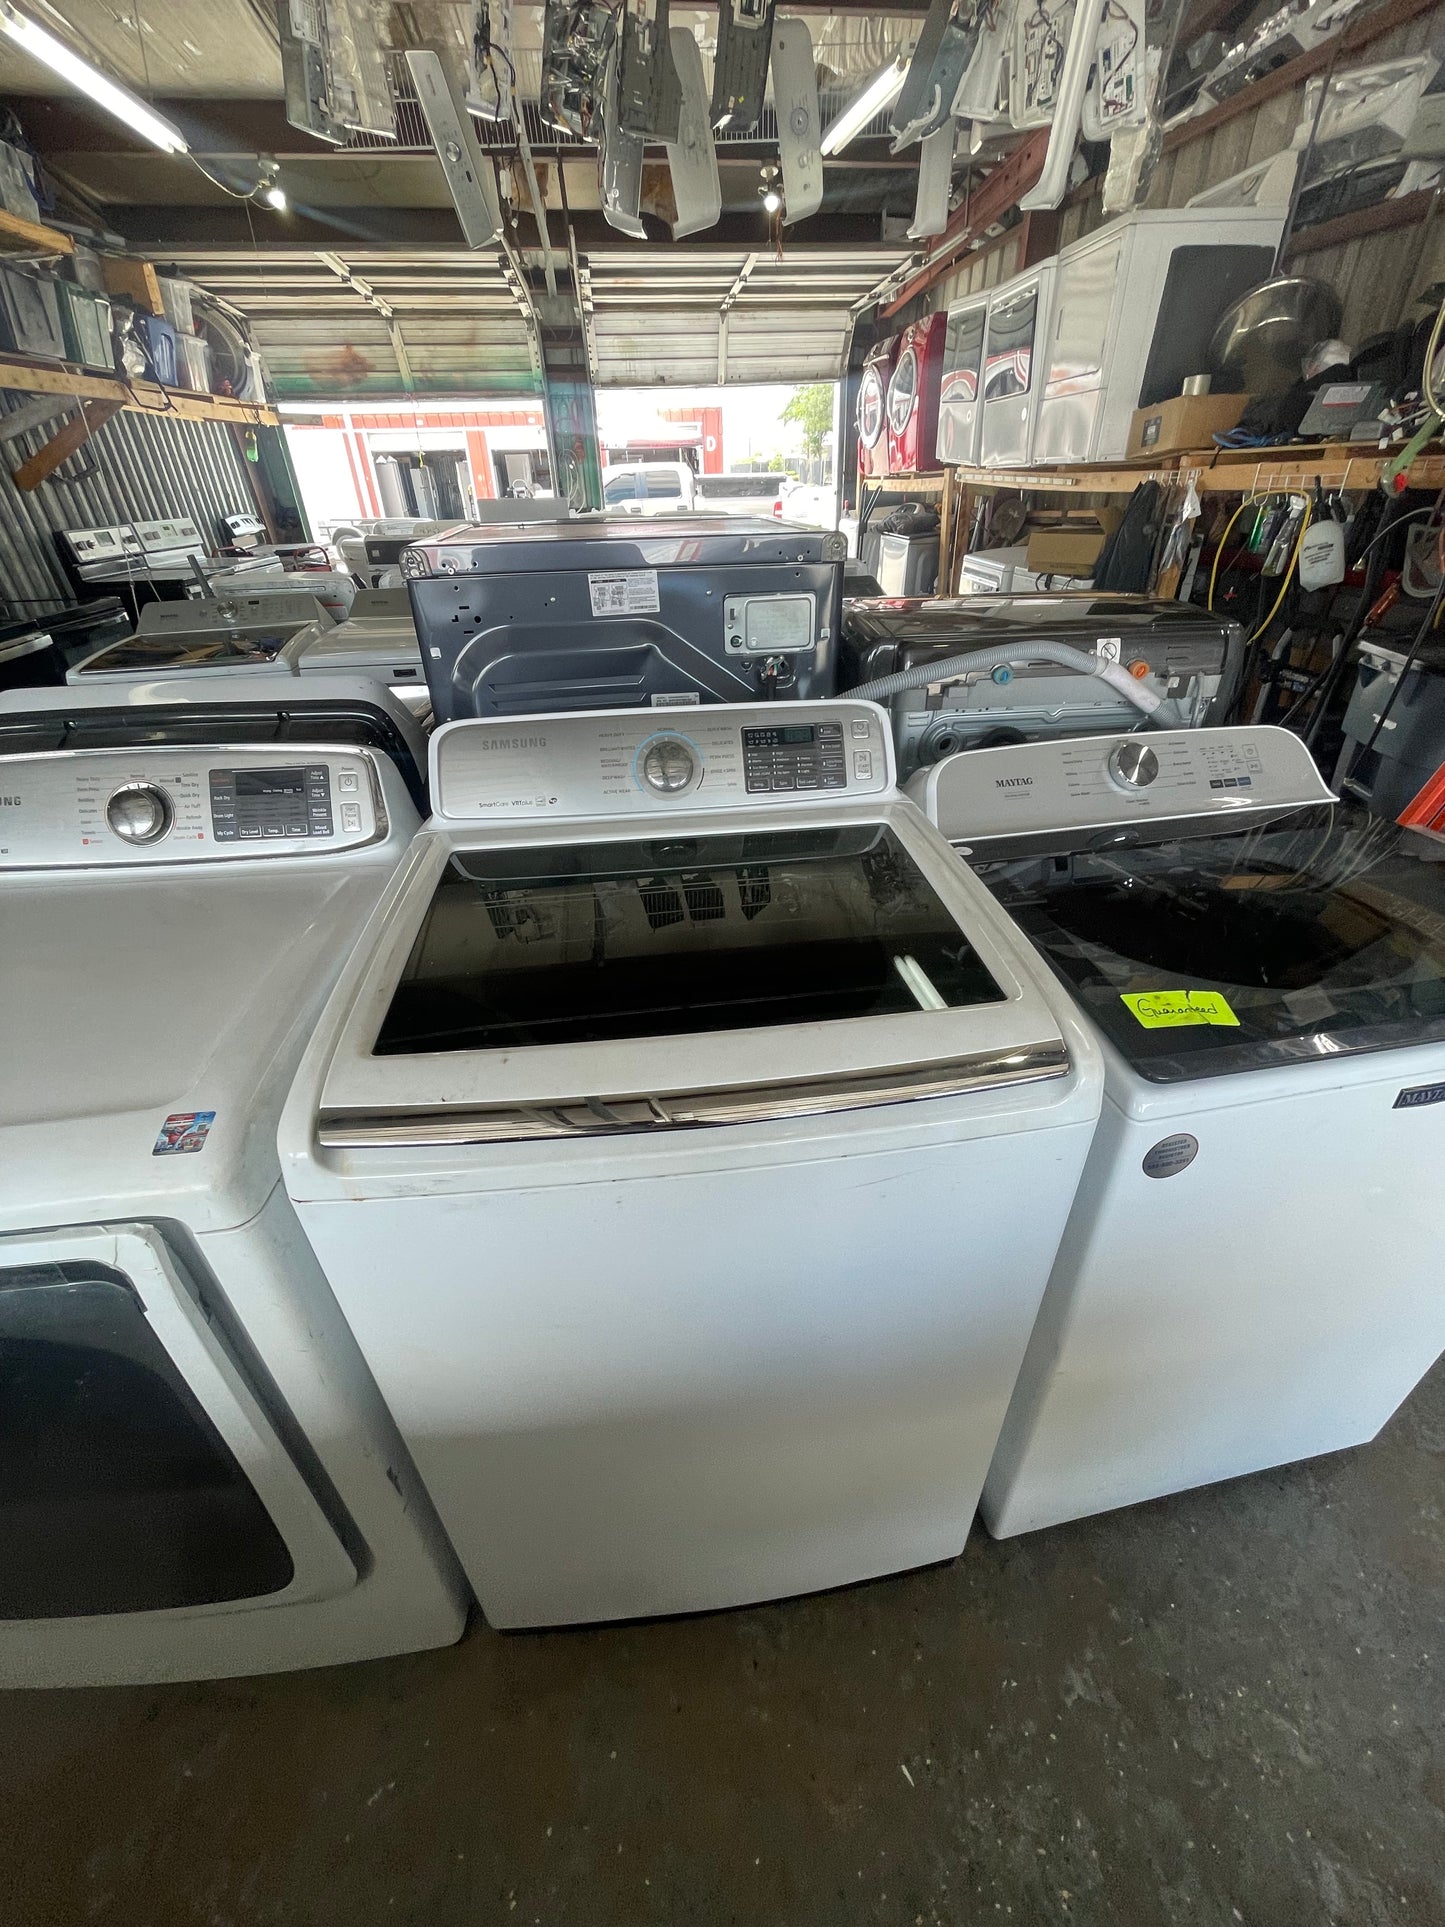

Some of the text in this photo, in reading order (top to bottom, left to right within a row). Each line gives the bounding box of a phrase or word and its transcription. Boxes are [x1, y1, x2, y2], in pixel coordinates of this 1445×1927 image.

[706, 436, 716, 452] D
[482, 737, 547, 751] SAMSUNG
[995, 777, 1033, 788] MAYTAG
[479, 800, 509, 808] SmartCare
[1137, 998, 1218, 1019] Guaranteed
